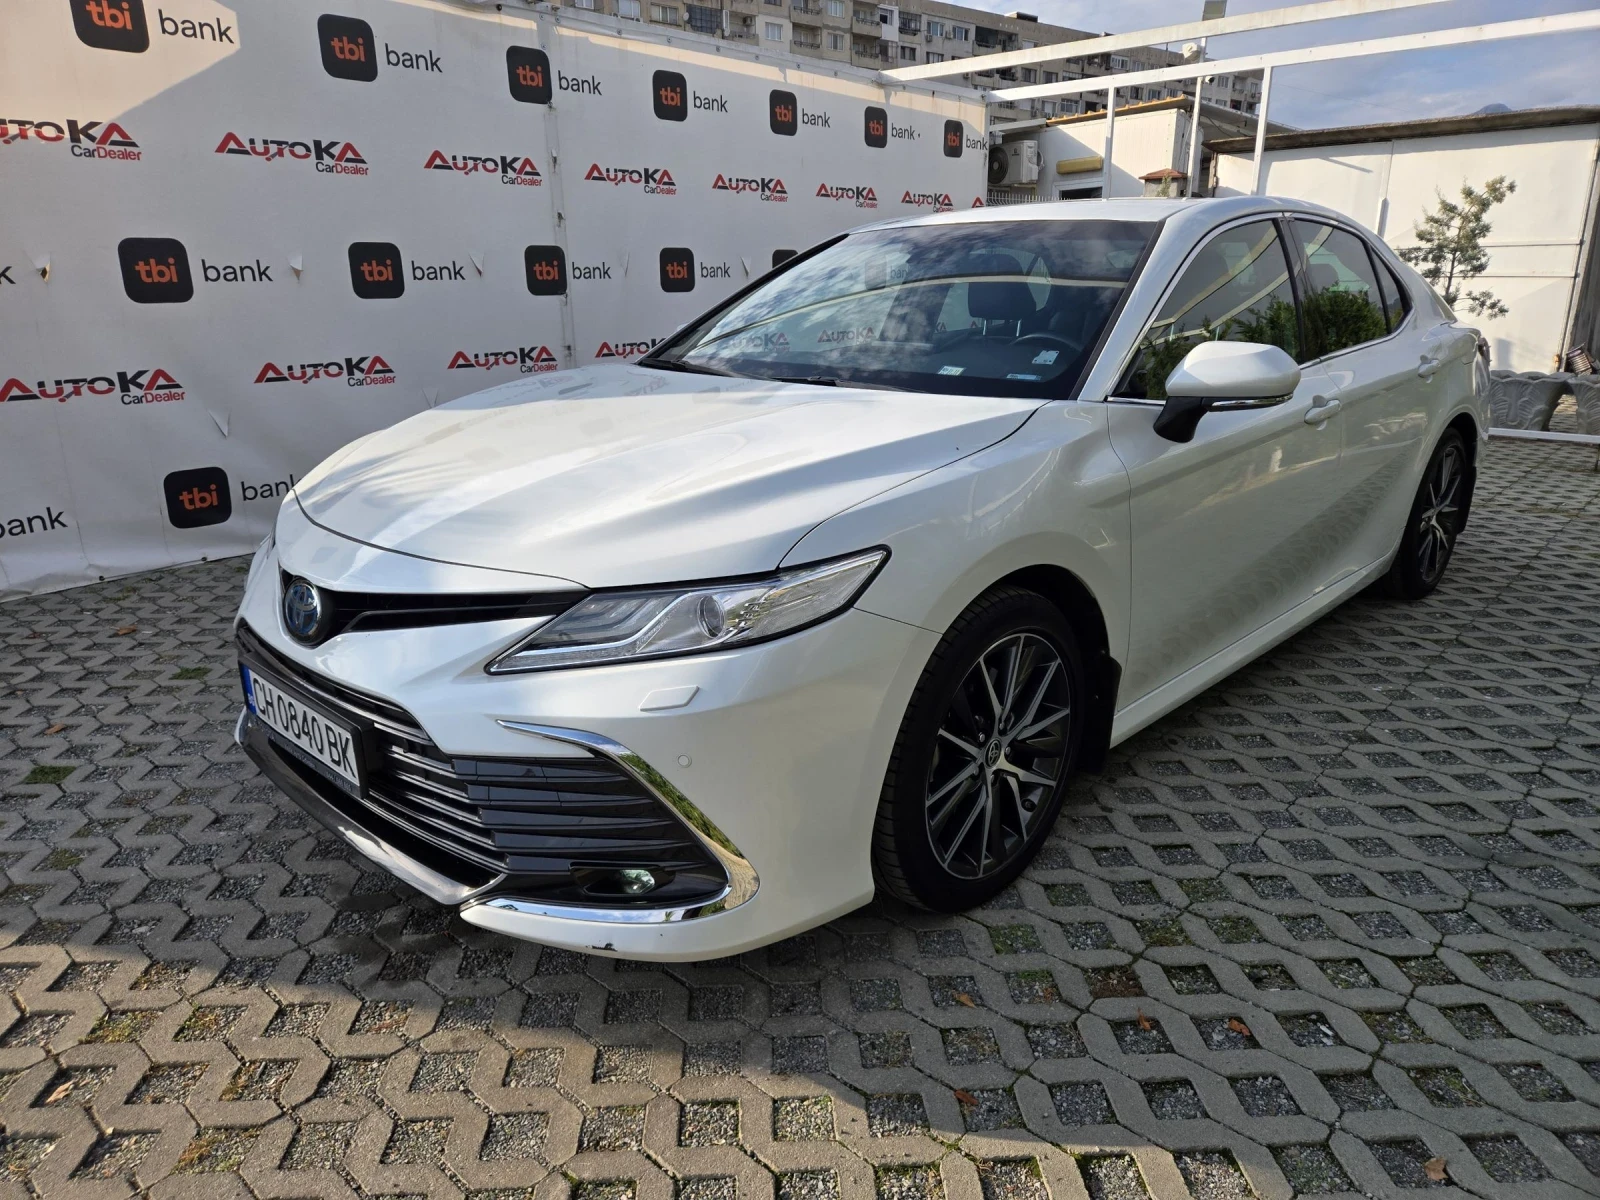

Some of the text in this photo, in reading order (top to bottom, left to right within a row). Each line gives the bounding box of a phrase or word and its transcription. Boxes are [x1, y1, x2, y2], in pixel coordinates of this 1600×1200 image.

[85, 0, 234, 44] tbi bank
[331, 37, 443, 73] tbi bank
[516, 66, 602, 95] tbi bank
[660, 87, 728, 113] tbi bank
[775, 105, 831, 128] tbi bank
[868, 120, 915, 140] tbi bank
[947, 132, 988, 150] tbi bank
[71, 145, 141, 161] CarDealer
[214, 132, 368, 165] AUTOKA
[315, 161, 369, 176] CarDealer
[424, 150, 541, 177] AUTOKA
[584, 163, 676, 186] AUTOKA
[501, 175, 542, 187] CarDealer
[644, 185, 677, 196] CarDealer
[712, 174, 788, 194] AUTOKA
[760, 193, 788, 202] CarDealer
[135, 257, 273, 283] tbi bank
[360, 259, 466, 282] tbi bank
[533, 260, 612, 281] tbi bank
[666, 261, 731, 279] tbi bank
[448, 345, 557, 371] AUTOKA
[520, 362, 558, 373] CarDealer
[254, 355, 395, 384] AUTOKA
[347, 375, 396, 387] CarDealer
[120, 391, 186, 405] CarDealer
[179, 484, 218, 510] tbi
